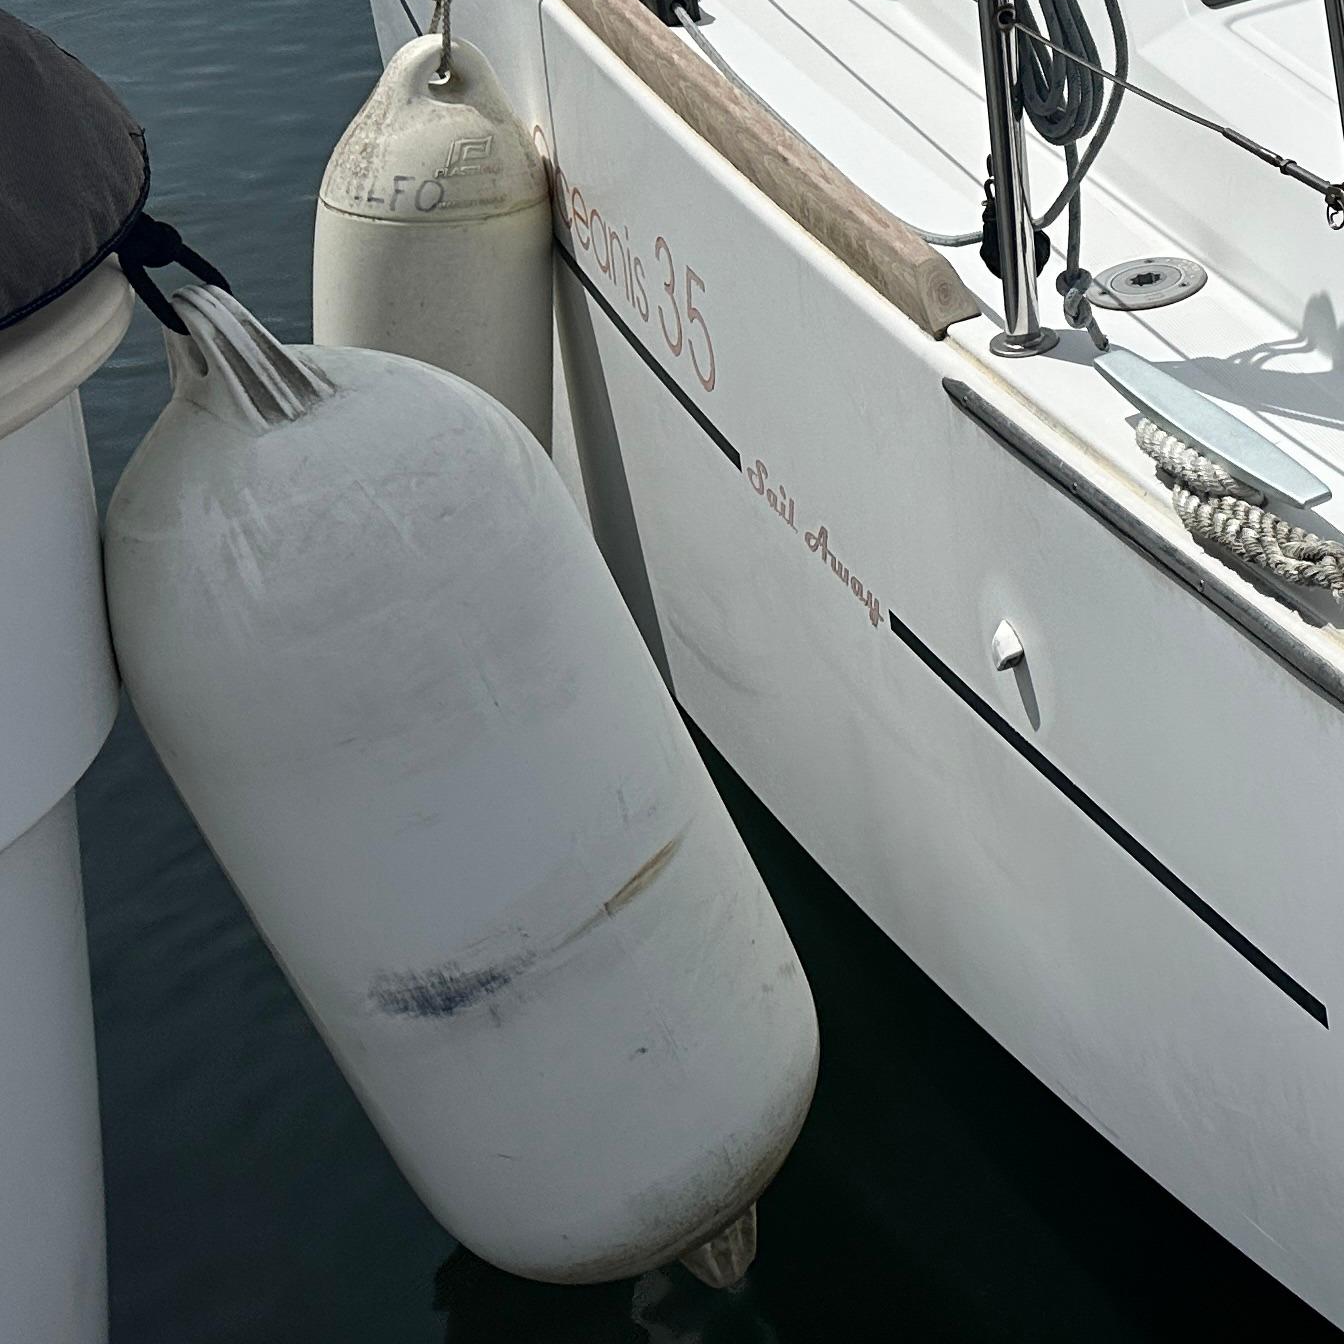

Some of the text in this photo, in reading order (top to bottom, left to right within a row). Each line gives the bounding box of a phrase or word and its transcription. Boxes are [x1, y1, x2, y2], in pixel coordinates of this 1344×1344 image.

[354, 175, 445, 213] LFO
[654, 236, 716, 393] 35
[747, 459, 885, 628] Sail Away
